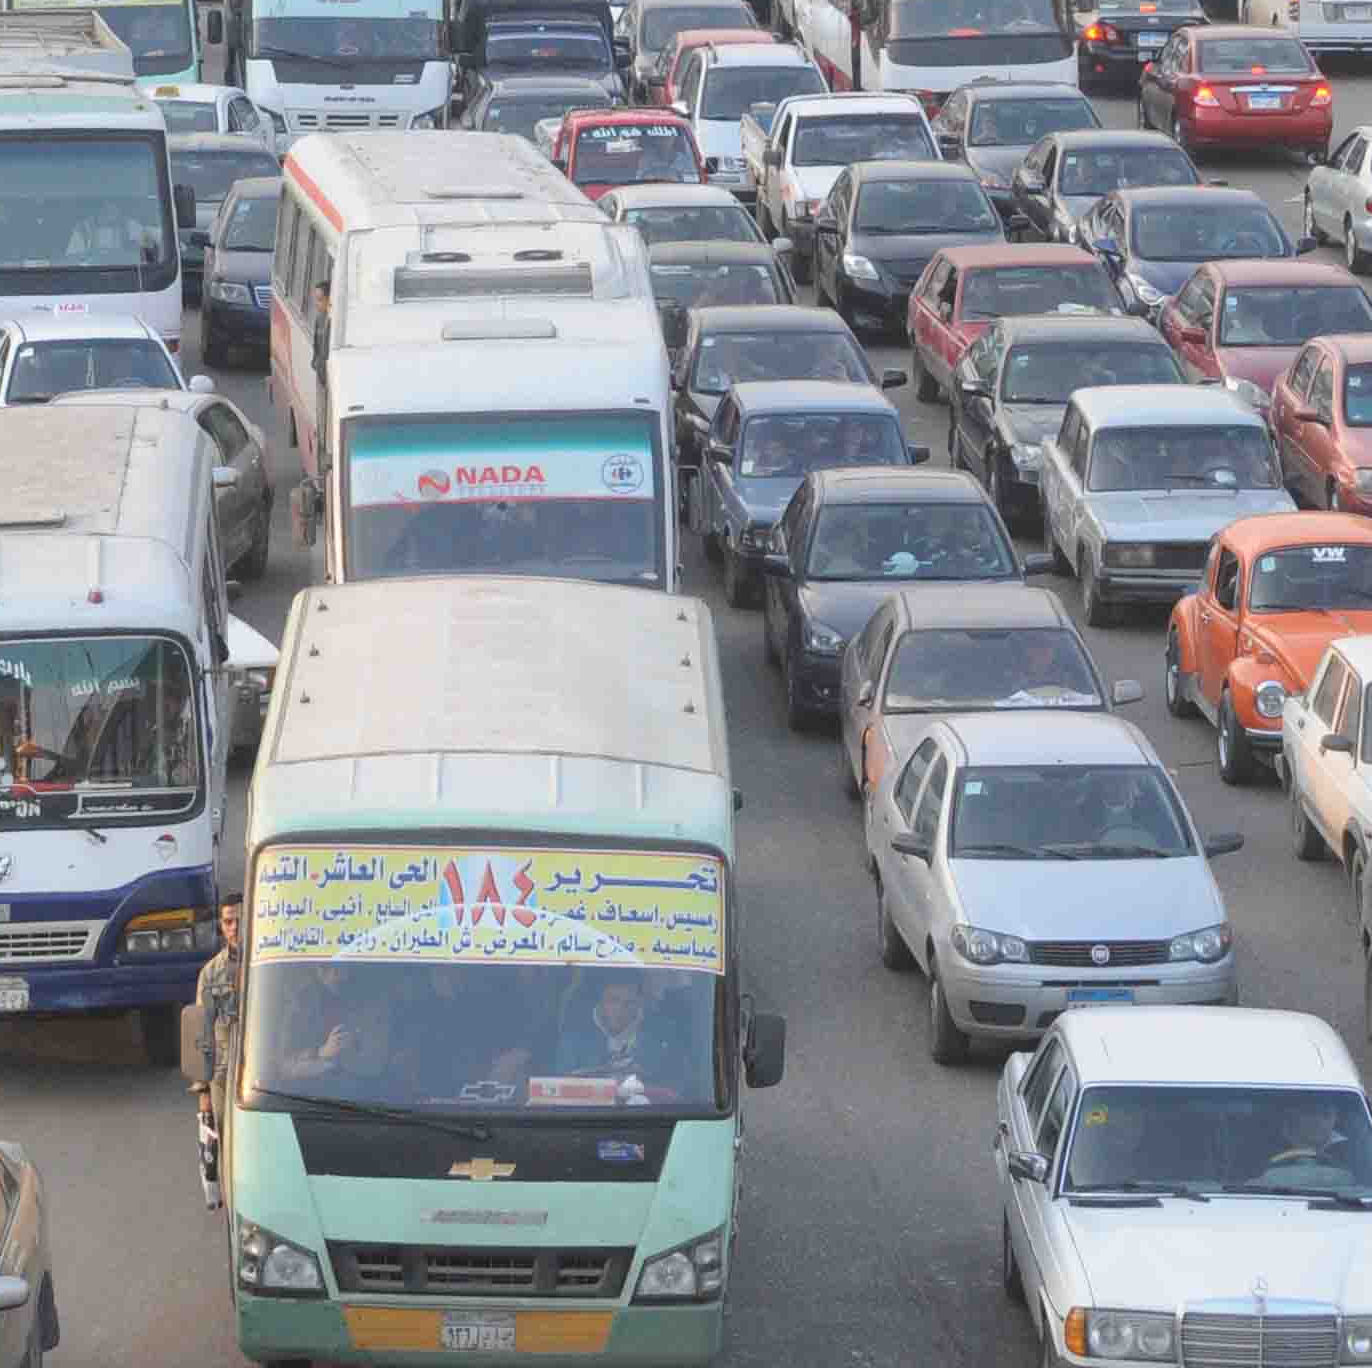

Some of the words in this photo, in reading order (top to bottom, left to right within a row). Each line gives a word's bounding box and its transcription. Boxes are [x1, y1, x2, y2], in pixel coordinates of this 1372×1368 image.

[456, 465, 546, 485] NADA
[1312, 546, 1346, 562] VW
[318, 851, 385, 888] العاشر
[442, 856, 536, 929] ١٨٤
